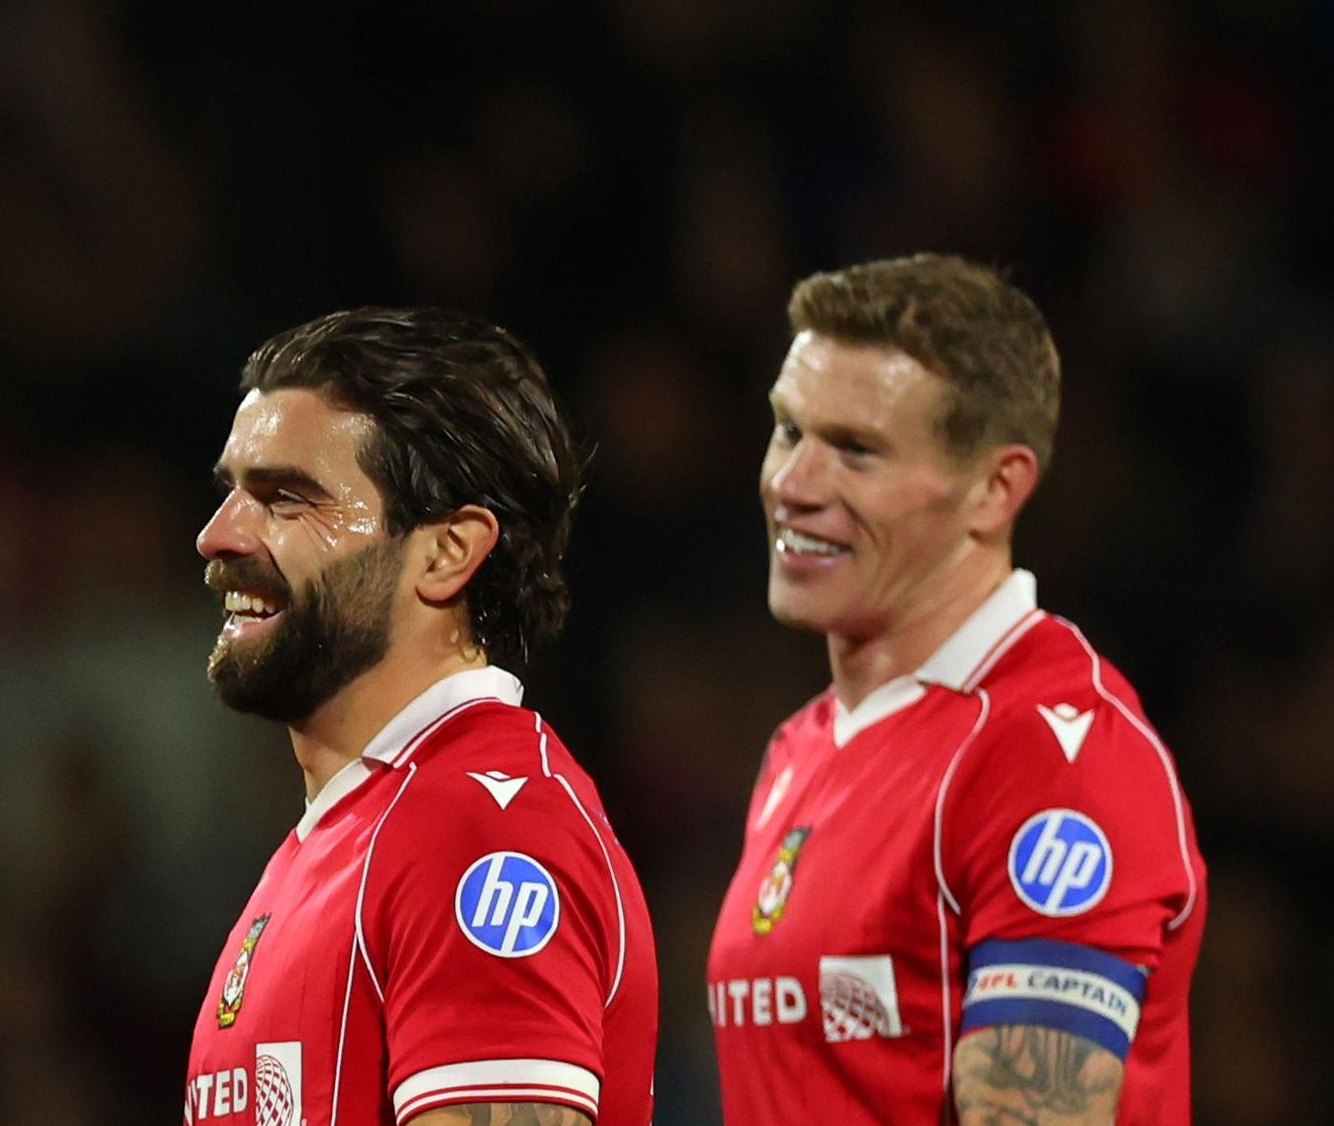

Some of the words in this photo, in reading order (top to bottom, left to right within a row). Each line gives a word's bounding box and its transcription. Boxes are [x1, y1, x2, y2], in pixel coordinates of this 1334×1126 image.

[471, 853, 549, 957] hp
[1021, 811, 1102, 914] hp
[1028, 970, 1127, 1016] CAPTAIN
